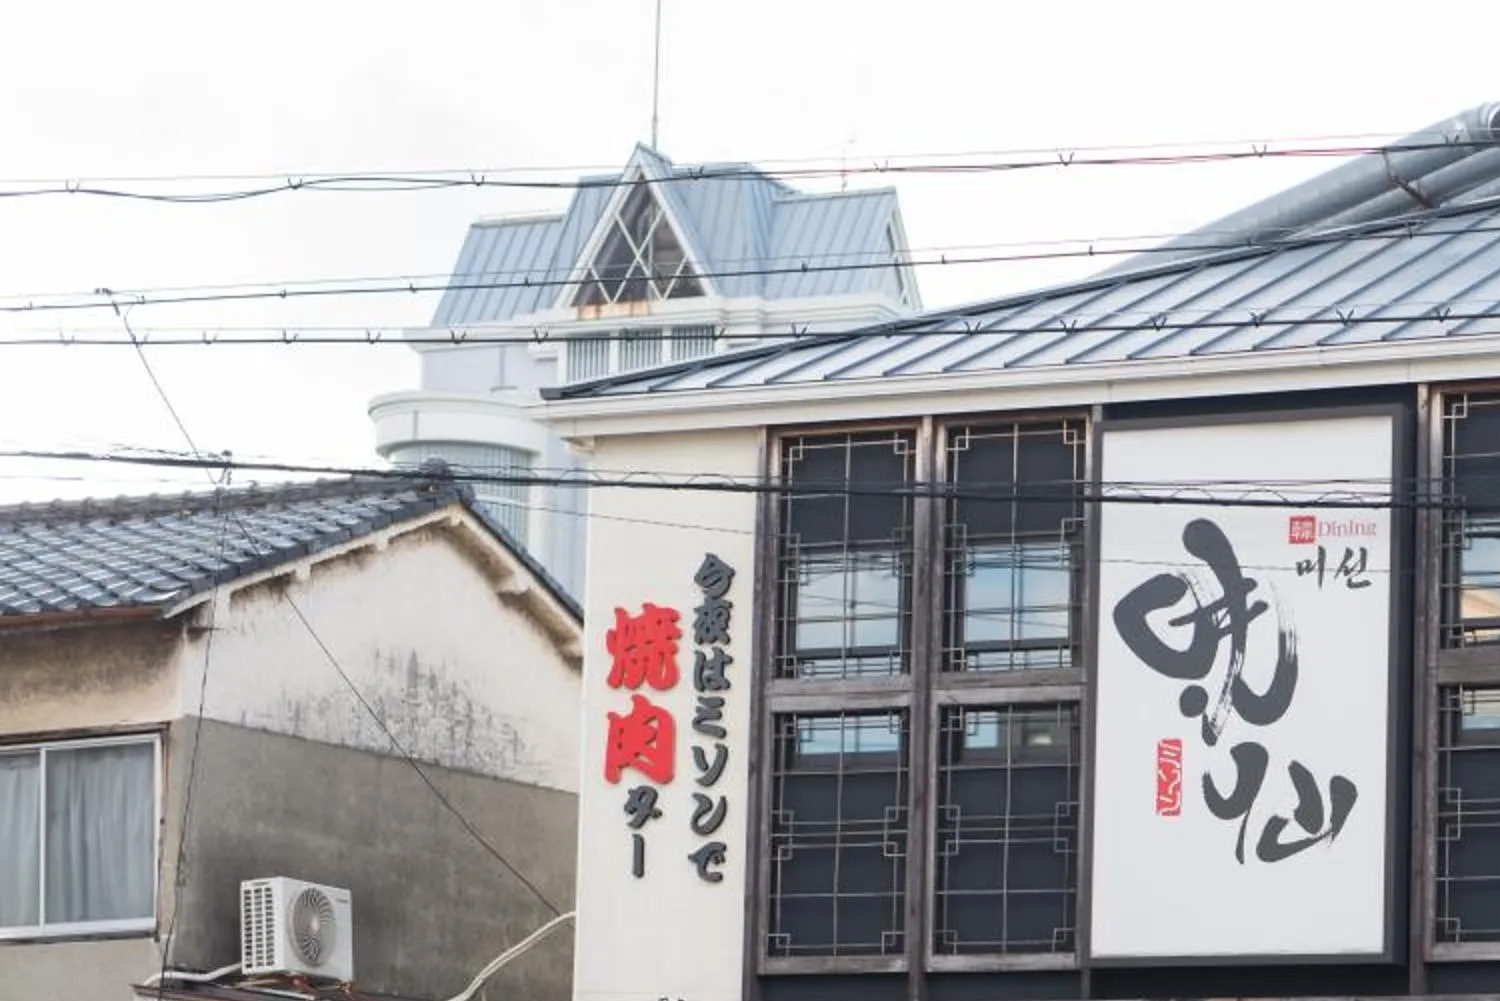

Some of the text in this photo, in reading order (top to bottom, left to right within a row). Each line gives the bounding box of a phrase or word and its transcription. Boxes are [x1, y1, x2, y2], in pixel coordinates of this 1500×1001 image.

[1319, 521, 1377, 538] Dining
[1295, 546, 1372, 589] 미선
[688, 552, 736, 884] 今夜はミソンで
